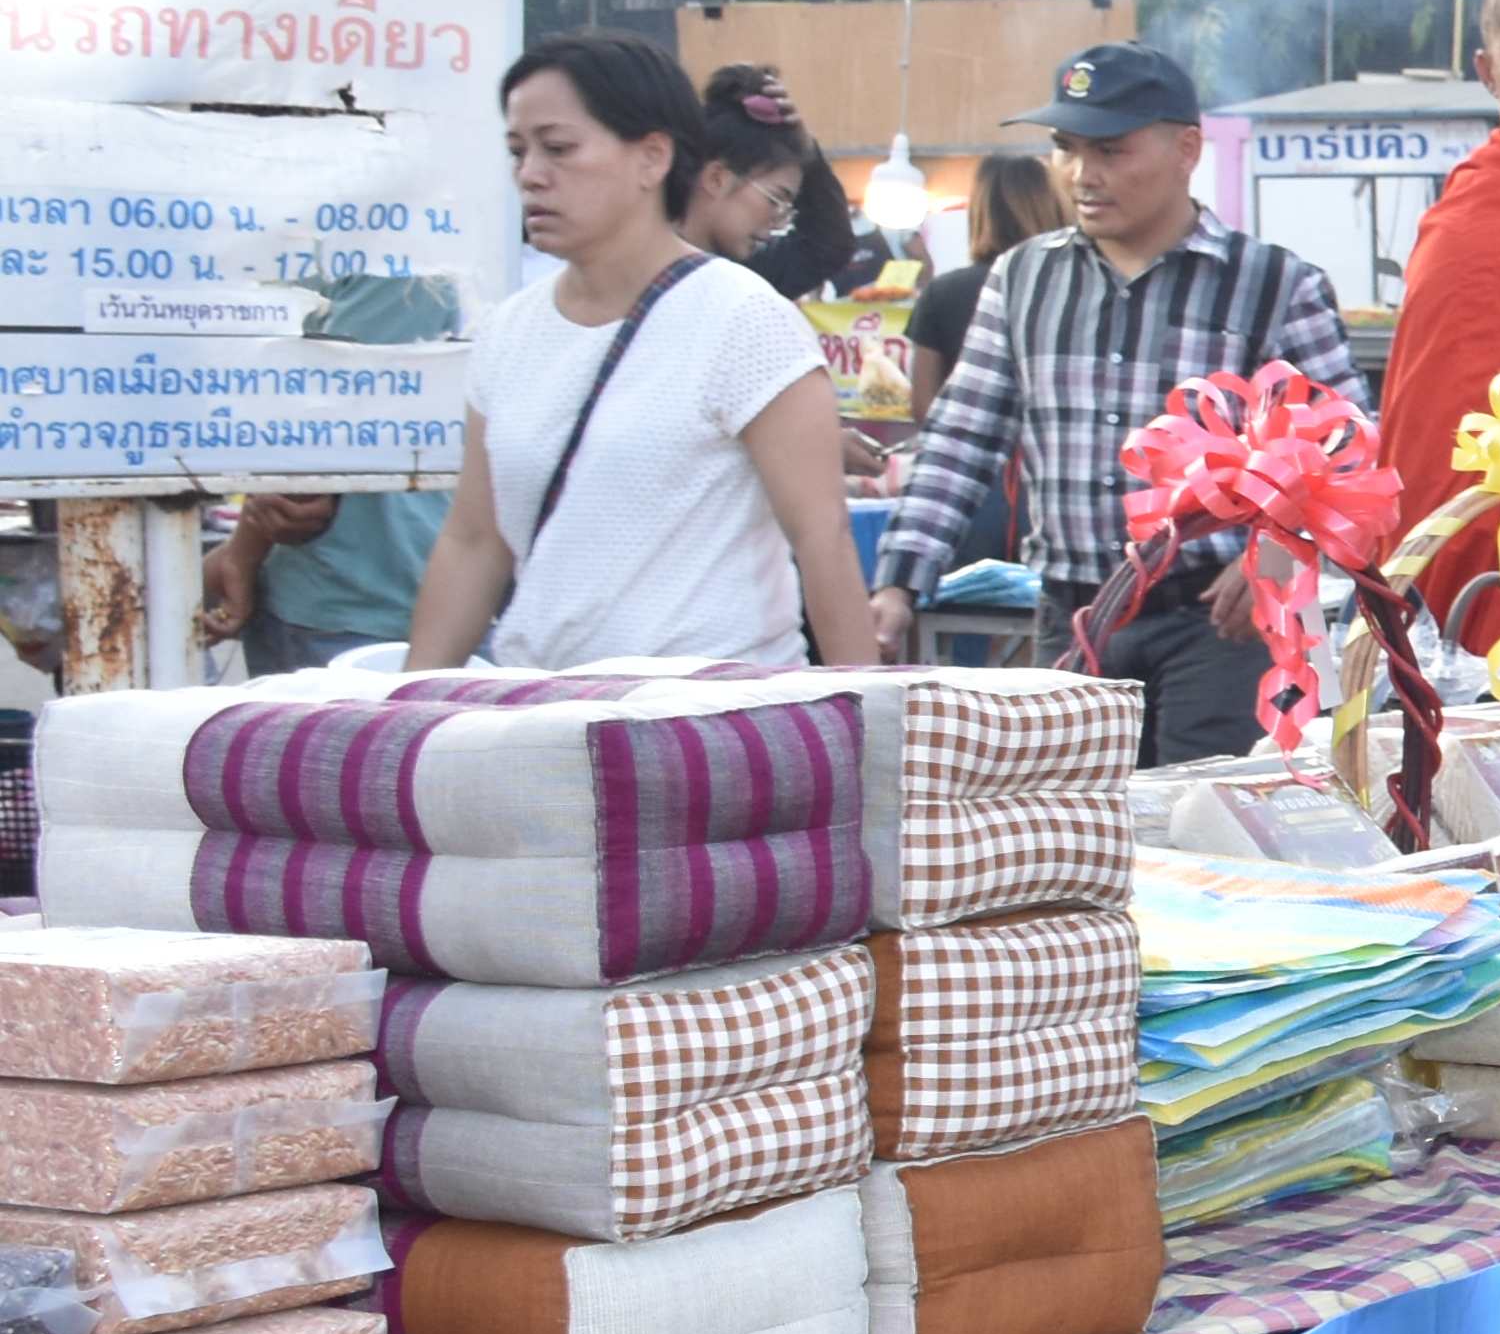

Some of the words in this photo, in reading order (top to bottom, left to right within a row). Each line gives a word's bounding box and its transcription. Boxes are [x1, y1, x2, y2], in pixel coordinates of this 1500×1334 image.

[1258, 122, 1430, 162] บาร์บีคิว
[0, 196, 91, 227] เวลา
[110, 197, 213, 231] 06.00
[230, 203, 265, 231] น.
[316, 202, 409, 231] 08.00
[425, 207, 460, 234] น.
[0, 248, 47, 276] ละ
[71, 247, 173, 279] 15.00
[189, 254, 225, 281] น.
[274, 250, 366, 279] 1700
[0, 407, 466, 464] ตำรวจภูธรเมืองมหาสารคา
